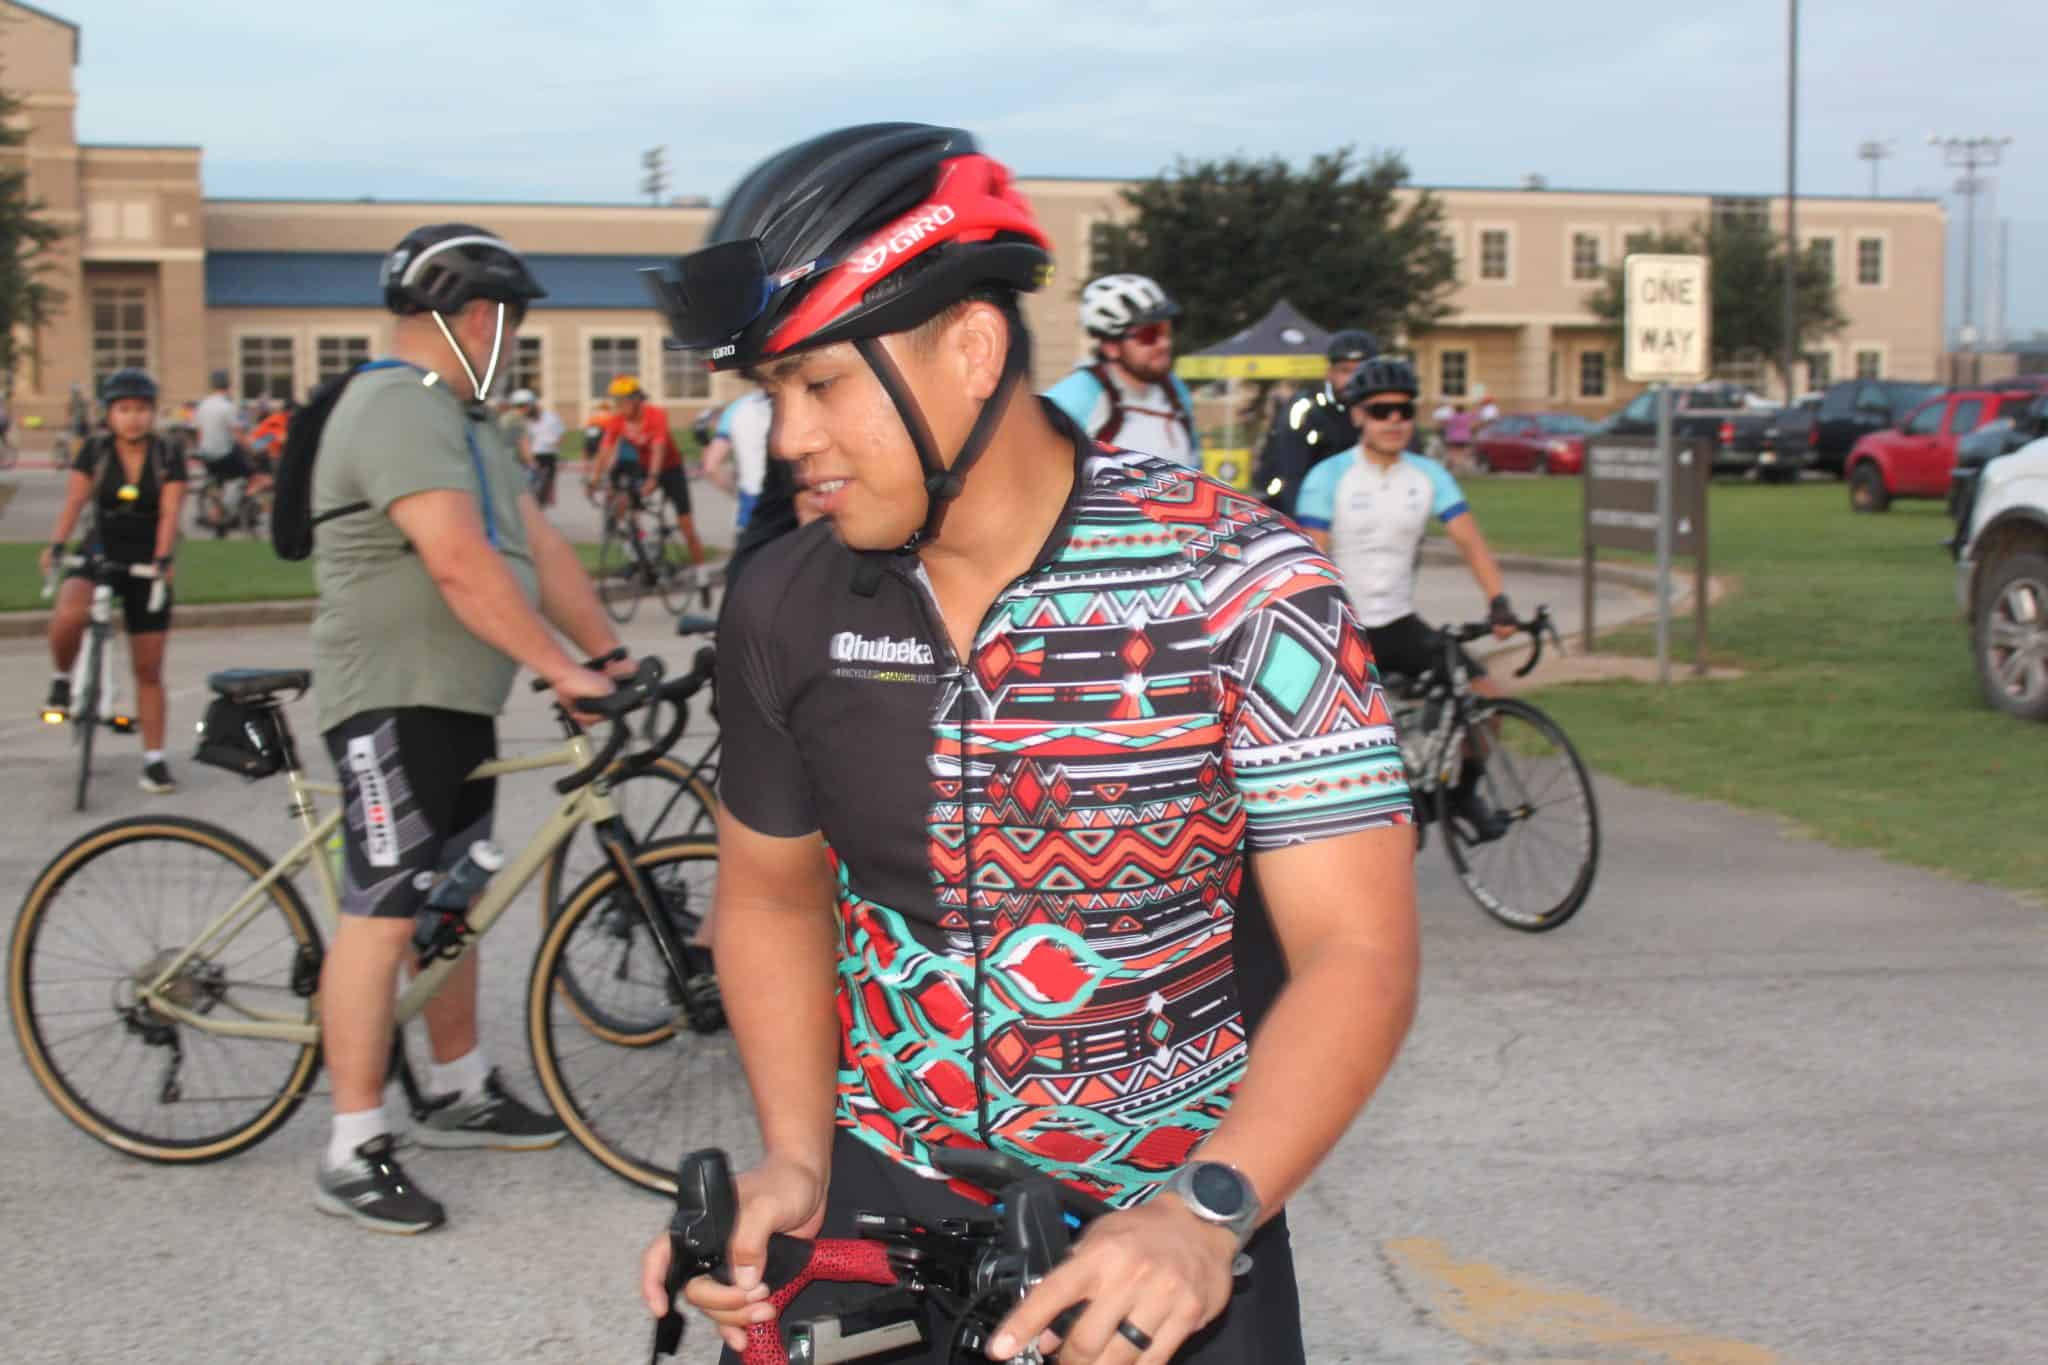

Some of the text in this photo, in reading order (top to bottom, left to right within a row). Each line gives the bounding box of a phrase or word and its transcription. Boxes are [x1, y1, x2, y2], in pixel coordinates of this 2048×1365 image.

[890, 205, 955, 254] GIRO
[1641, 276, 1695, 305] ONE
[1640, 328, 1695, 352] WAY
[832, 631, 936, 665] Qhubeka
